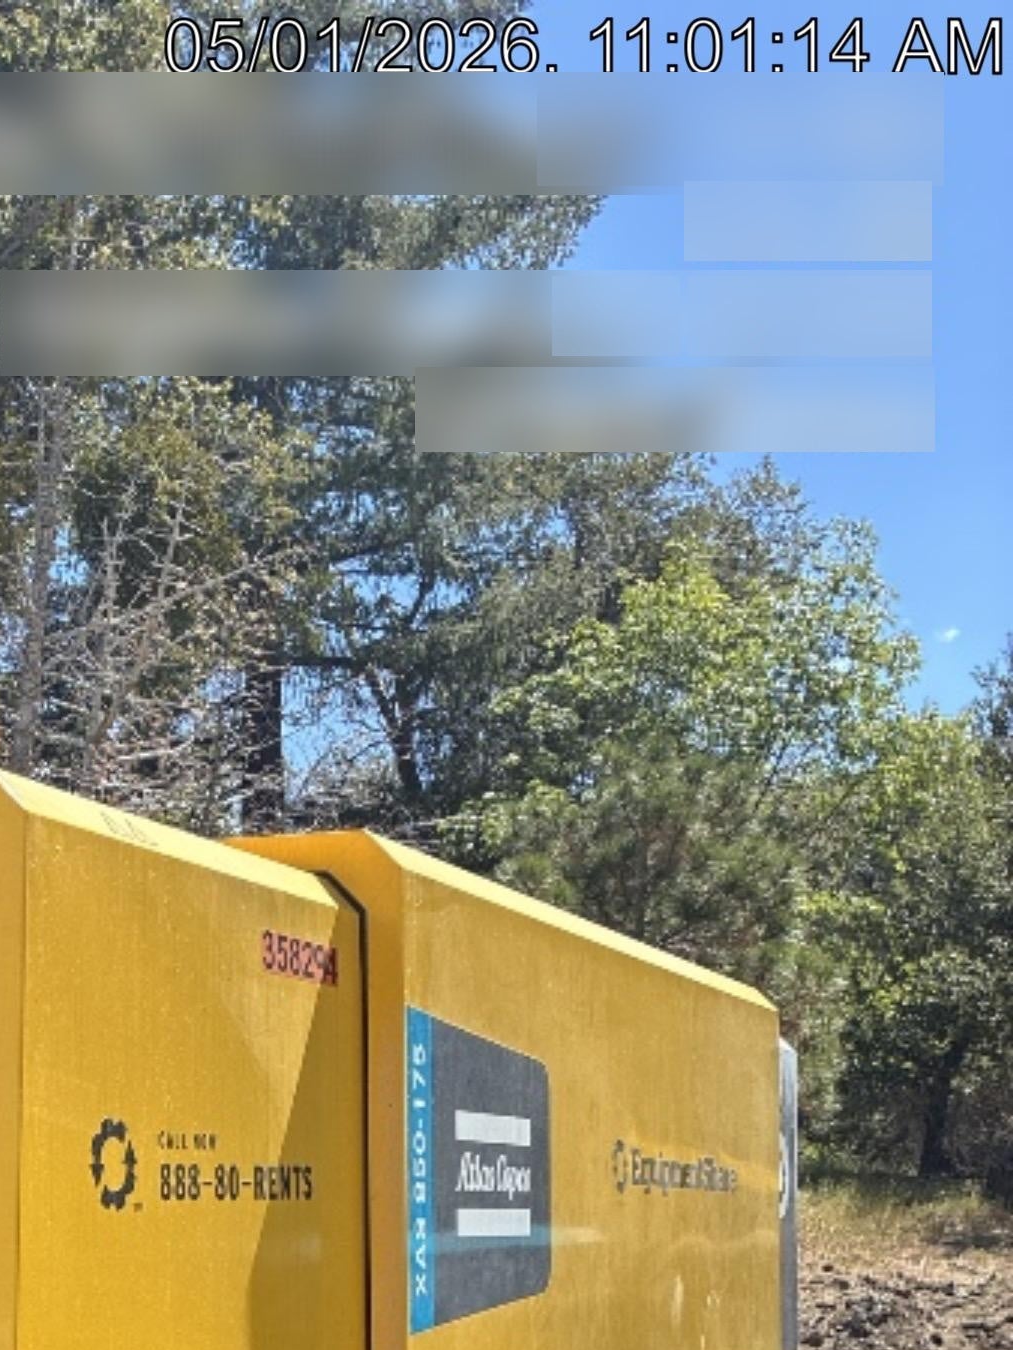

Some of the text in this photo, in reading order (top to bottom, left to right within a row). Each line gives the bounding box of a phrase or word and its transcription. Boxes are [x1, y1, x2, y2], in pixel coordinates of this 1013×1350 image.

[262, 929, 339, 985] 358294
[159, 1163, 313, 1201] 888-80-RENTS
[455, 1152, 495, 1192] Atlas
